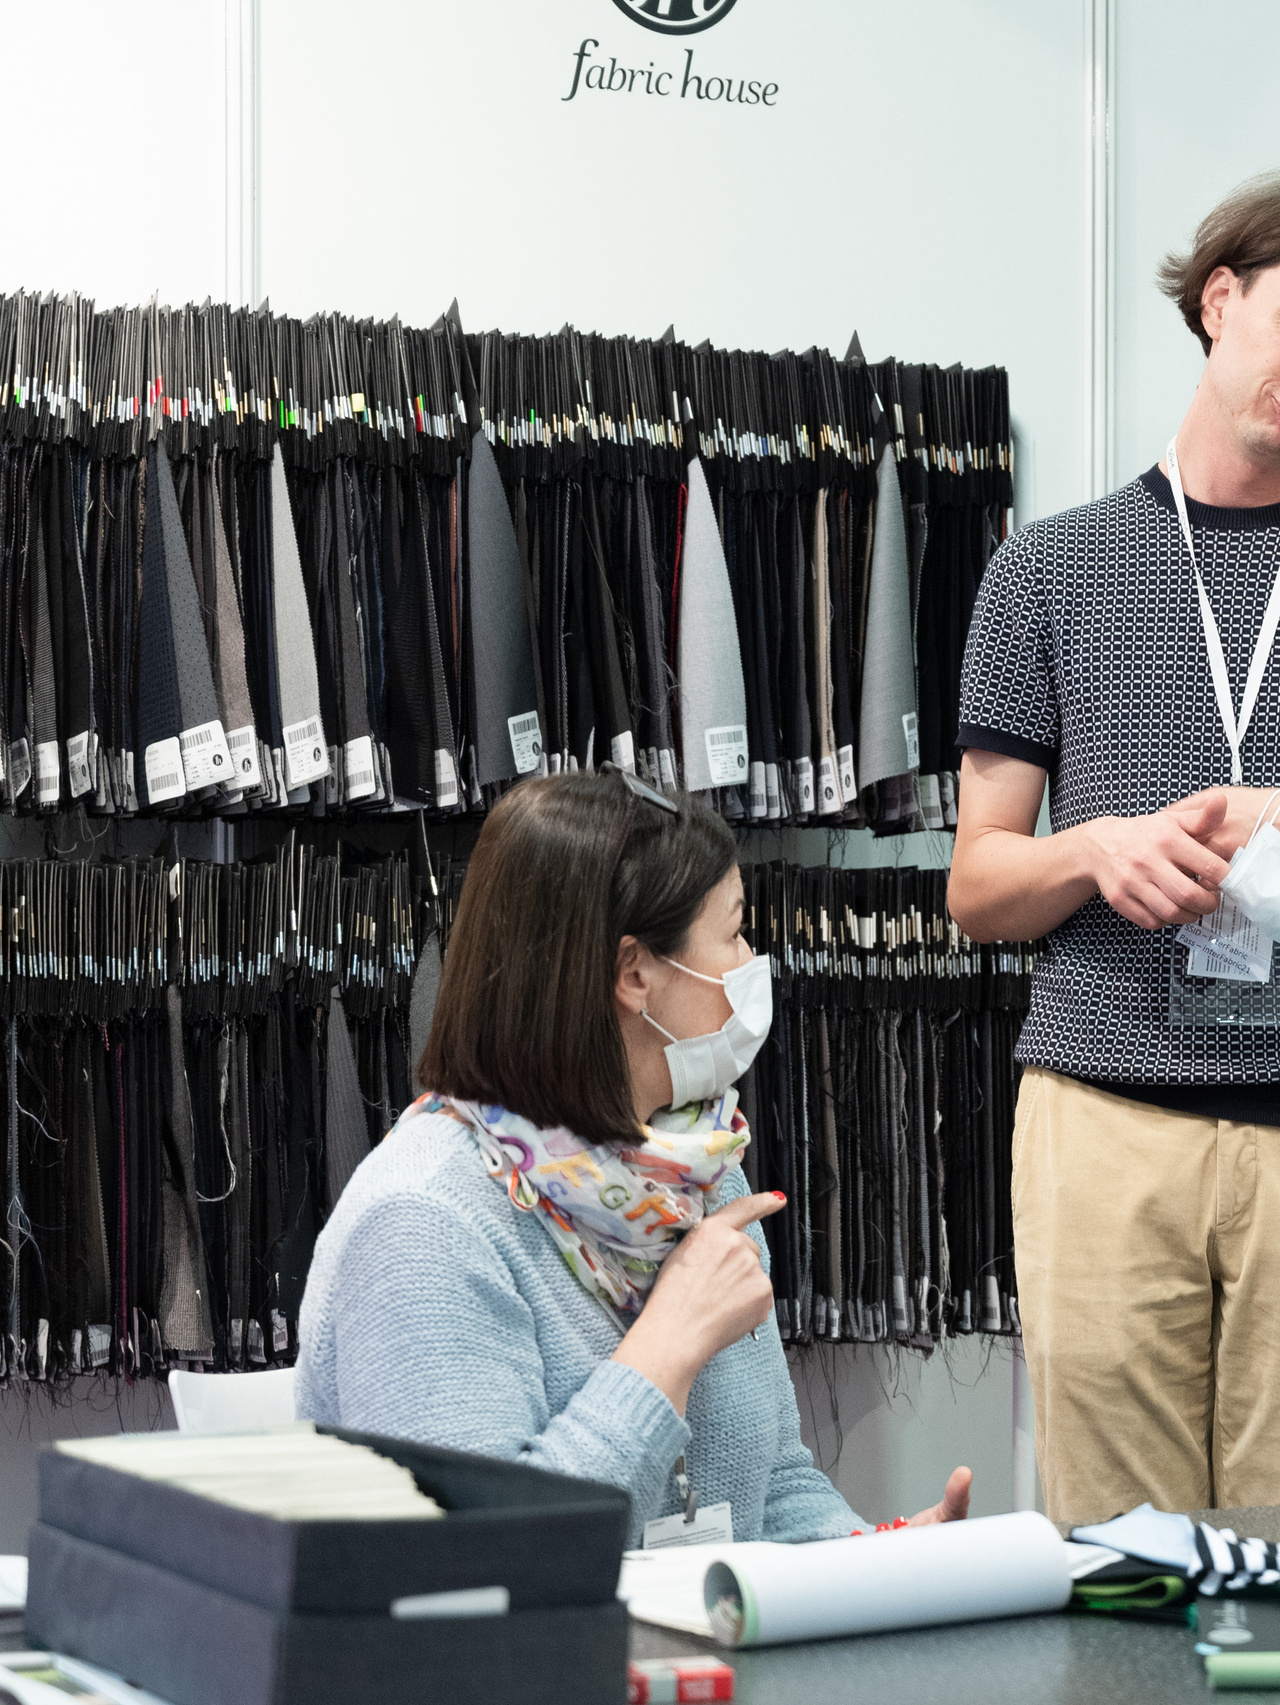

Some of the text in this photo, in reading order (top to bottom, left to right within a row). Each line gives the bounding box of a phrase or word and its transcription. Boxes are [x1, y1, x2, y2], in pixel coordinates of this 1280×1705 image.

[561, 38, 779, 106] fabric house
[1178, 933, 1196, 947] Pass
[1184, 923, 1202, 936] SSID
[1207, 935, 1249, 960] IterFabric
